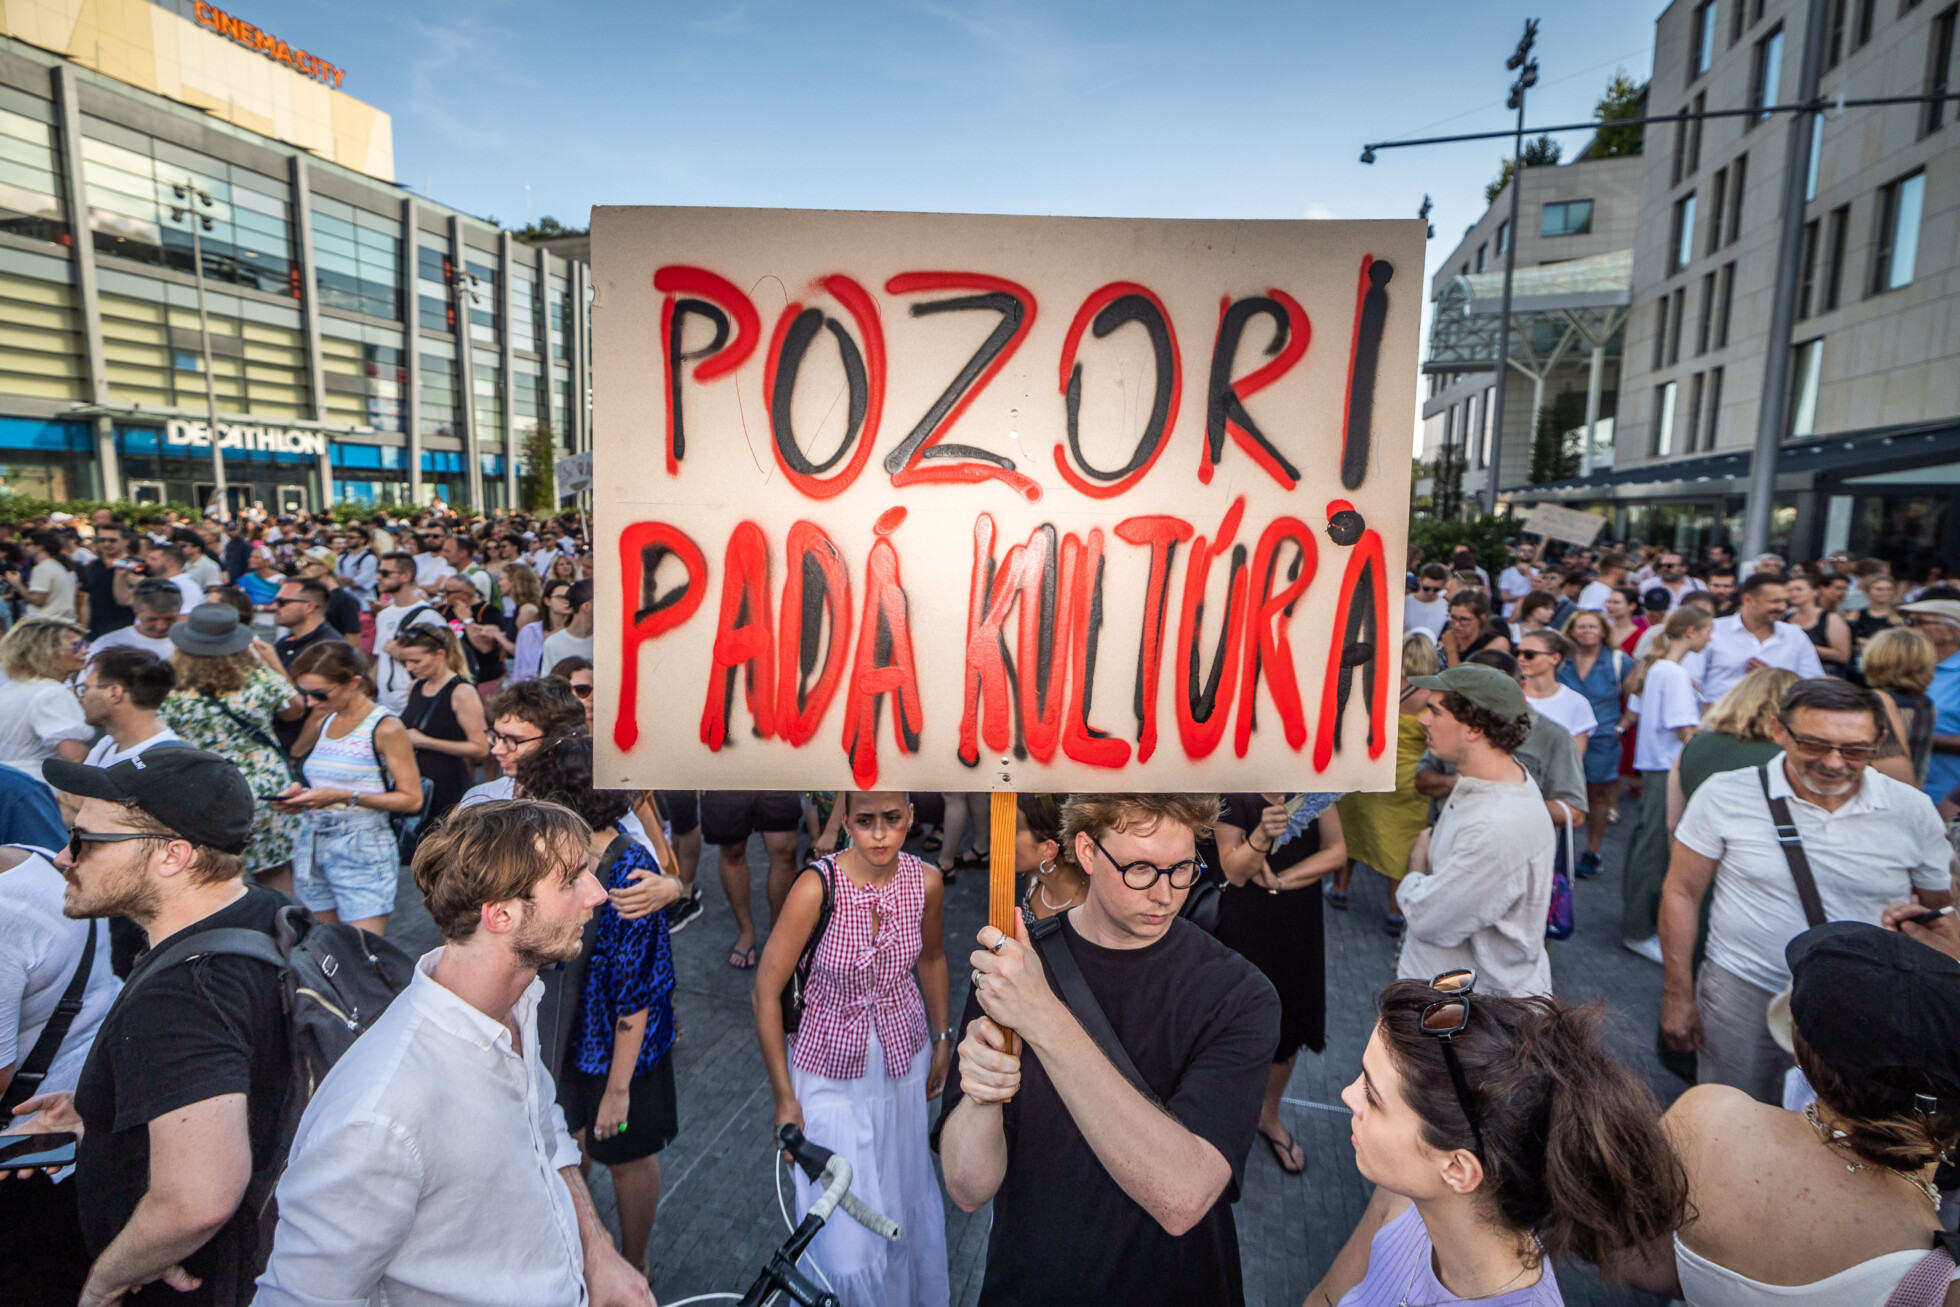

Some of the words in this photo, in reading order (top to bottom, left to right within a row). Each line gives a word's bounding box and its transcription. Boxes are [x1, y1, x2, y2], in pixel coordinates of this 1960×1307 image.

[194, 0, 294, 65] CINEMA
[295, 49, 345, 88] CITY
[166, 418, 326, 455] DECATHLON
[613, 505, 924, 791] PADÁ
[957, 494, 1391, 774] KULTÚRA
